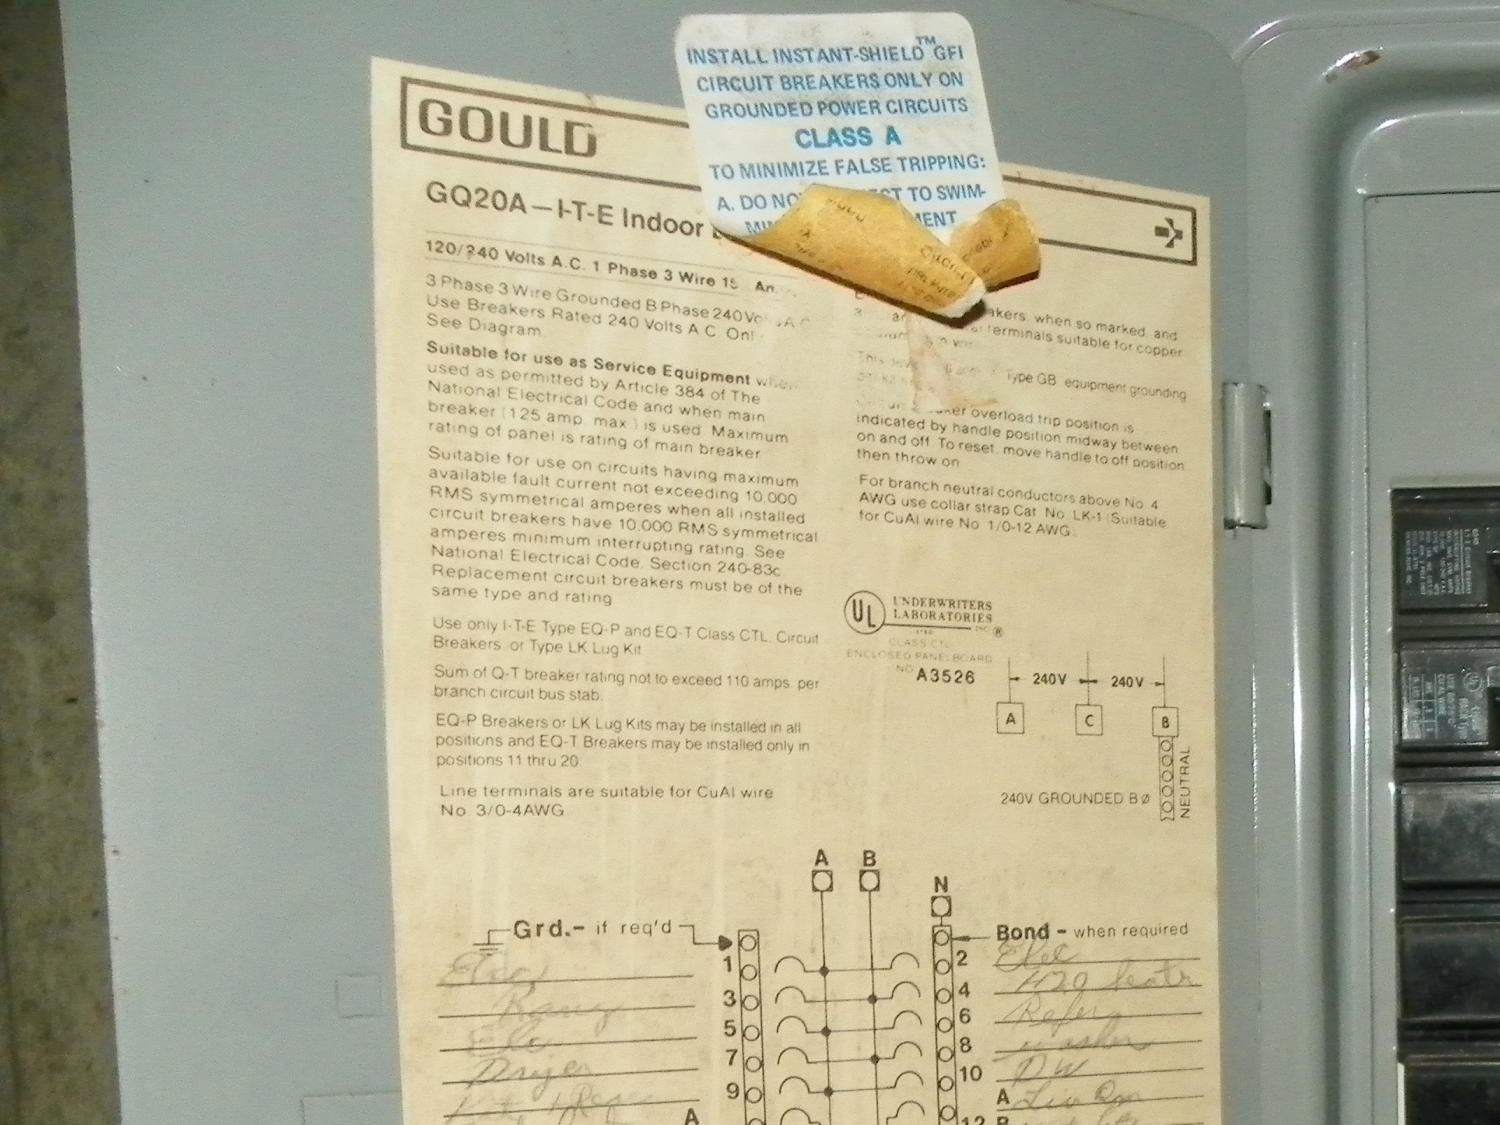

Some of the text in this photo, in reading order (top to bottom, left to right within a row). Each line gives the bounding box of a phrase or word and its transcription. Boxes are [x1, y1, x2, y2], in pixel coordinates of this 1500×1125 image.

[687, 49, 768, 65] INSTALL
[934, 45, 963, 61] GFI
[697, 72, 963, 92] CIRCUIT BREAKERS ONLY ON
[705, 97, 968, 118] GROUNDED POWER CIRCUITS
[418, 98, 597, 158] GOULD
[795, 125, 901, 148] CLASS A
[709, 154, 985, 179] TO MINIMIZE FALSE TRIPPING:
[718, 197, 734, 211] A.
[740, 194, 767, 210] DO
[907, 186, 932, 201] TO
[936, 184, 986, 200] SWIM-
[623, 208, 704, 237] Indoor
[505, 250, 545, 265] Volts
[592, 261, 600, 272] 1
[608, 262, 657, 279] Phase
[664, 269, 672, 281] 3
[679, 272, 715, 286] Wire
[427, 340, 749, 387] Suitable for use as Service Equipment
[857, 415, 1178, 454] indicated by handle position midway between
[894, 609, 992, 623] LABORATORIES
[917, 668, 974, 684] A3526
[1033, 673, 1066, 685] 240V
[1112, 676, 1143, 687] 240V
[1006, 713, 1016, 724] A
[1085, 714, 1093, 727] C
[1162, 716, 1169, 728] B
[441, 785, 477, 797] Line
[484, 785, 562, 797] terminals
[568, 788, 594, 797] are
[601, 786, 664, 798] suitable
[670, 786, 691, 797] for
[741, 789, 773, 799] wire
[1180, 749, 1190, 818] NEUTRAL
[1001, 792, 1138, 804] 240V GROUNDED B
[815, 849, 828, 866] A
[863, 850, 876, 867] B
[935, 876, 948, 893] N
[597, 921, 607, 935] if
[620, 919, 672, 937] req'd
[996, 923, 1188, 941] Bond when required
[724, 956, 731, 972] 1
[957, 950, 967, 966] 2
[958, 982, 970, 997] 4
[724, 990, 736, 1007] 3
[959, 1008, 971, 1024] 6
[725, 1020, 736, 1037] 5
[960, 1037, 972, 1053] 8
[726, 1049, 738, 1066] 7
[960, 1065, 982, 1082] 10
[727, 1083, 739, 1099] 9
[997, 1088, 1009, 1104] A
[685, 1108, 699, 1125] A
